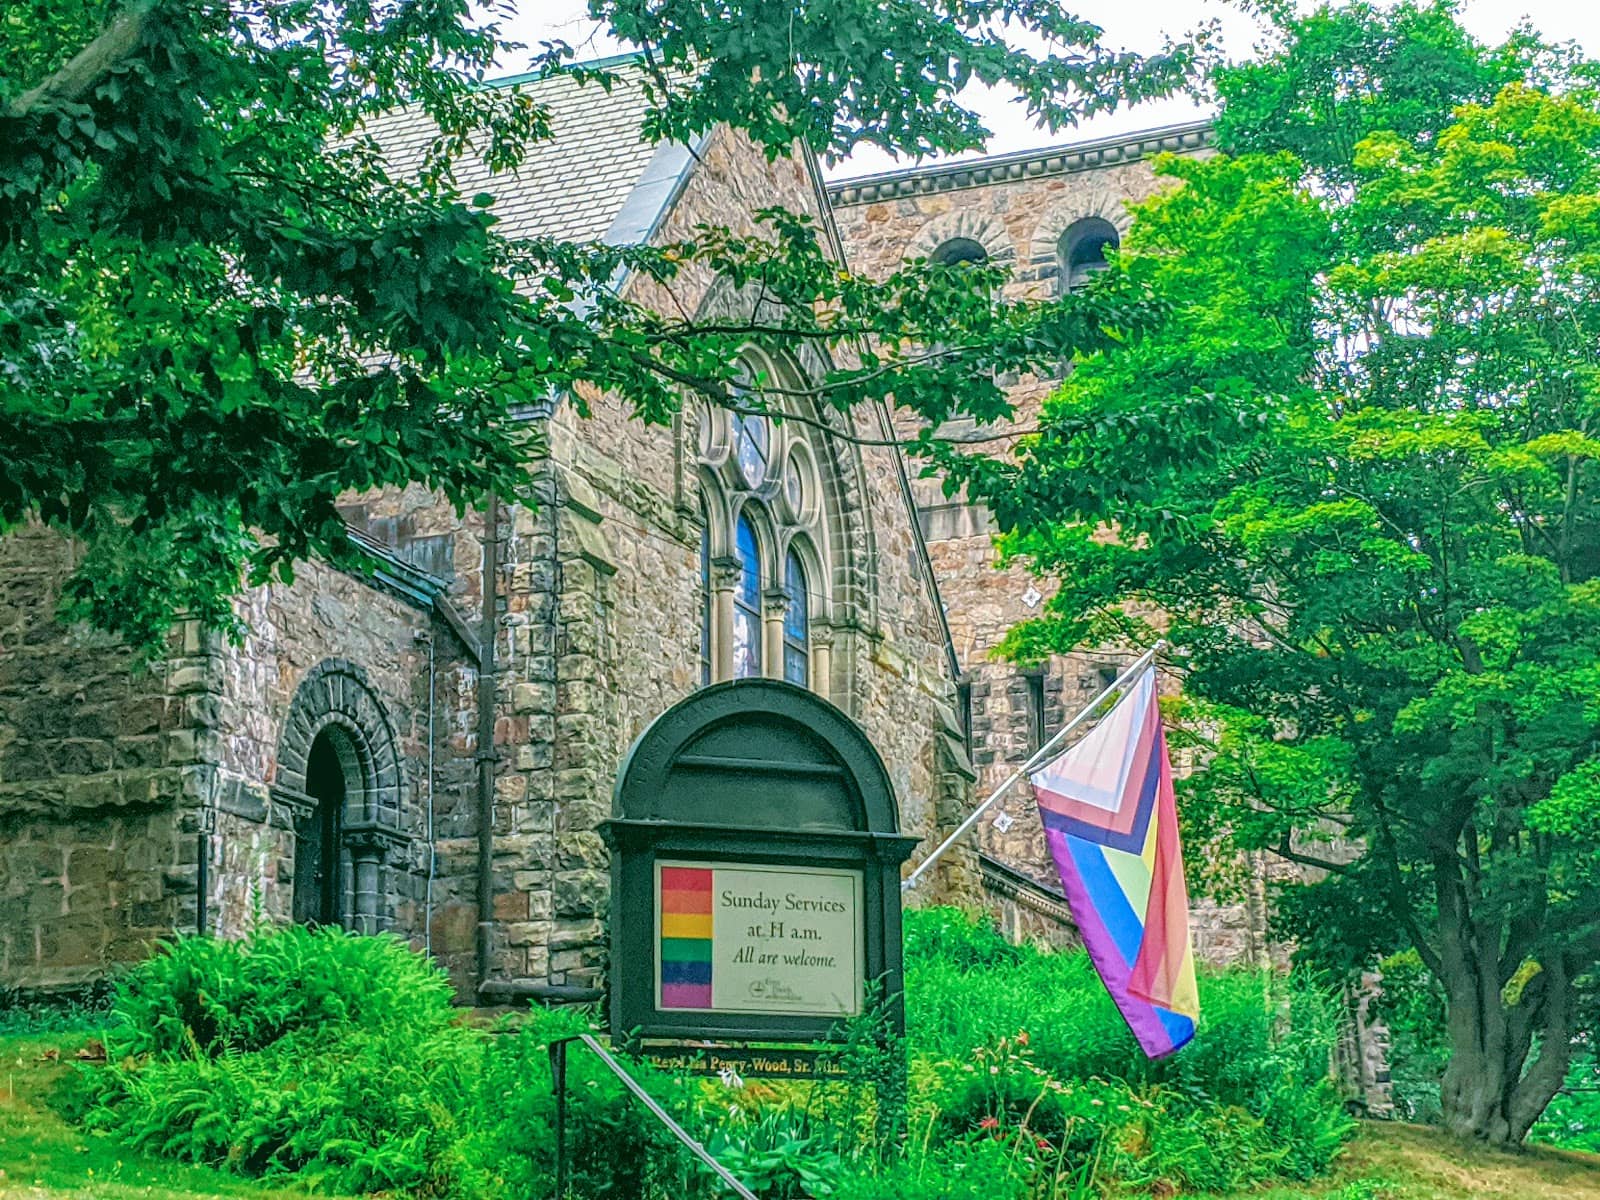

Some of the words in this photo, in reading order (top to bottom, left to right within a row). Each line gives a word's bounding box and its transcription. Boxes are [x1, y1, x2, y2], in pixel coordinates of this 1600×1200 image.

[721, 890, 780, 915] Sunday
[785, 893, 846, 913] Services
[747, 924, 763, 938] at
[791, 927, 822, 941] a.m.
[732, 946, 754, 964] All
[758, 954, 778, 965] are
[783, 949, 837, 968] welcome.
[794, 1058, 812, 1073] Sr.
